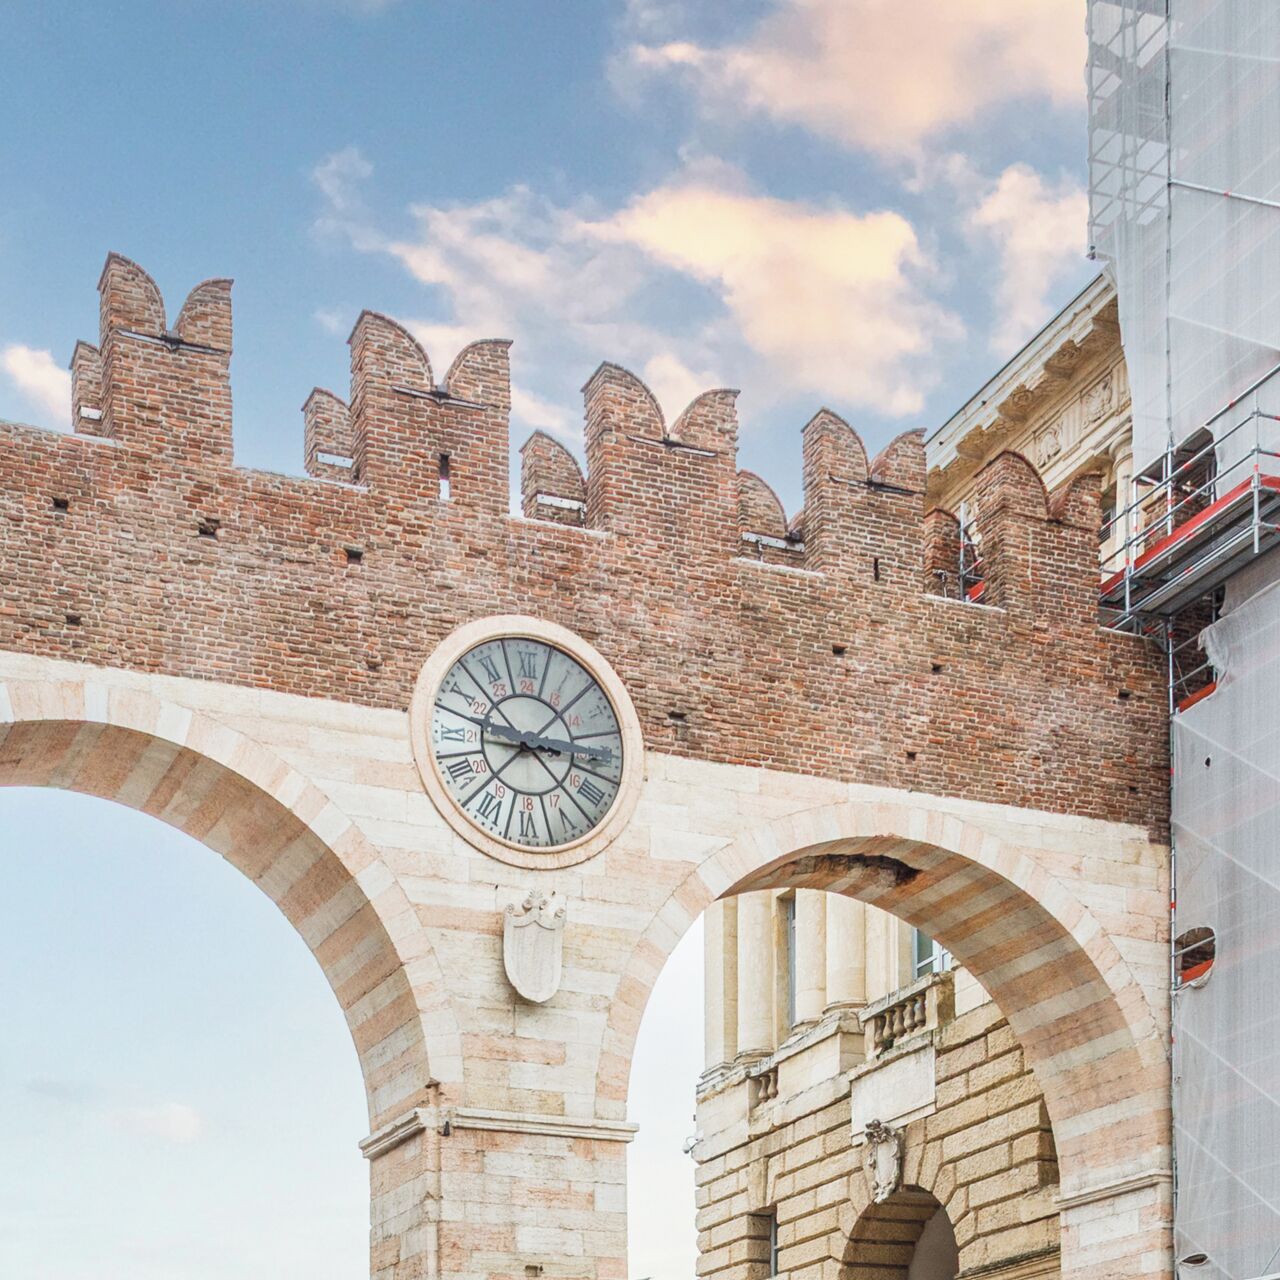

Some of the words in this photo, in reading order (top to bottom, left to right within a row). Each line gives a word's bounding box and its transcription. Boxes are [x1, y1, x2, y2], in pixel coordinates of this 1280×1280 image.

[479, 655, 501, 684] XI
[517, 650, 538, 679] XII
[492, 683, 507, 697] 23
[520, 680, 534, 693] 24
[449, 681, 476, 707] X
[550, 691, 561, 706] 13
[473, 701, 487, 715] 22
[568, 713, 580, 727] 14
[441, 723, 465, 743] IX
[466, 730, 477, 743] 21
[473, 759, 487, 773] 20
[570, 774, 580, 788] 16
[495, 784, 506, 798] 19
[522, 797, 534, 811] 18
[549, 794, 560, 808] 17
[476, 791, 503, 827] VII
[519, 811, 539, 839] VI
[558, 807, 578, 834] V
